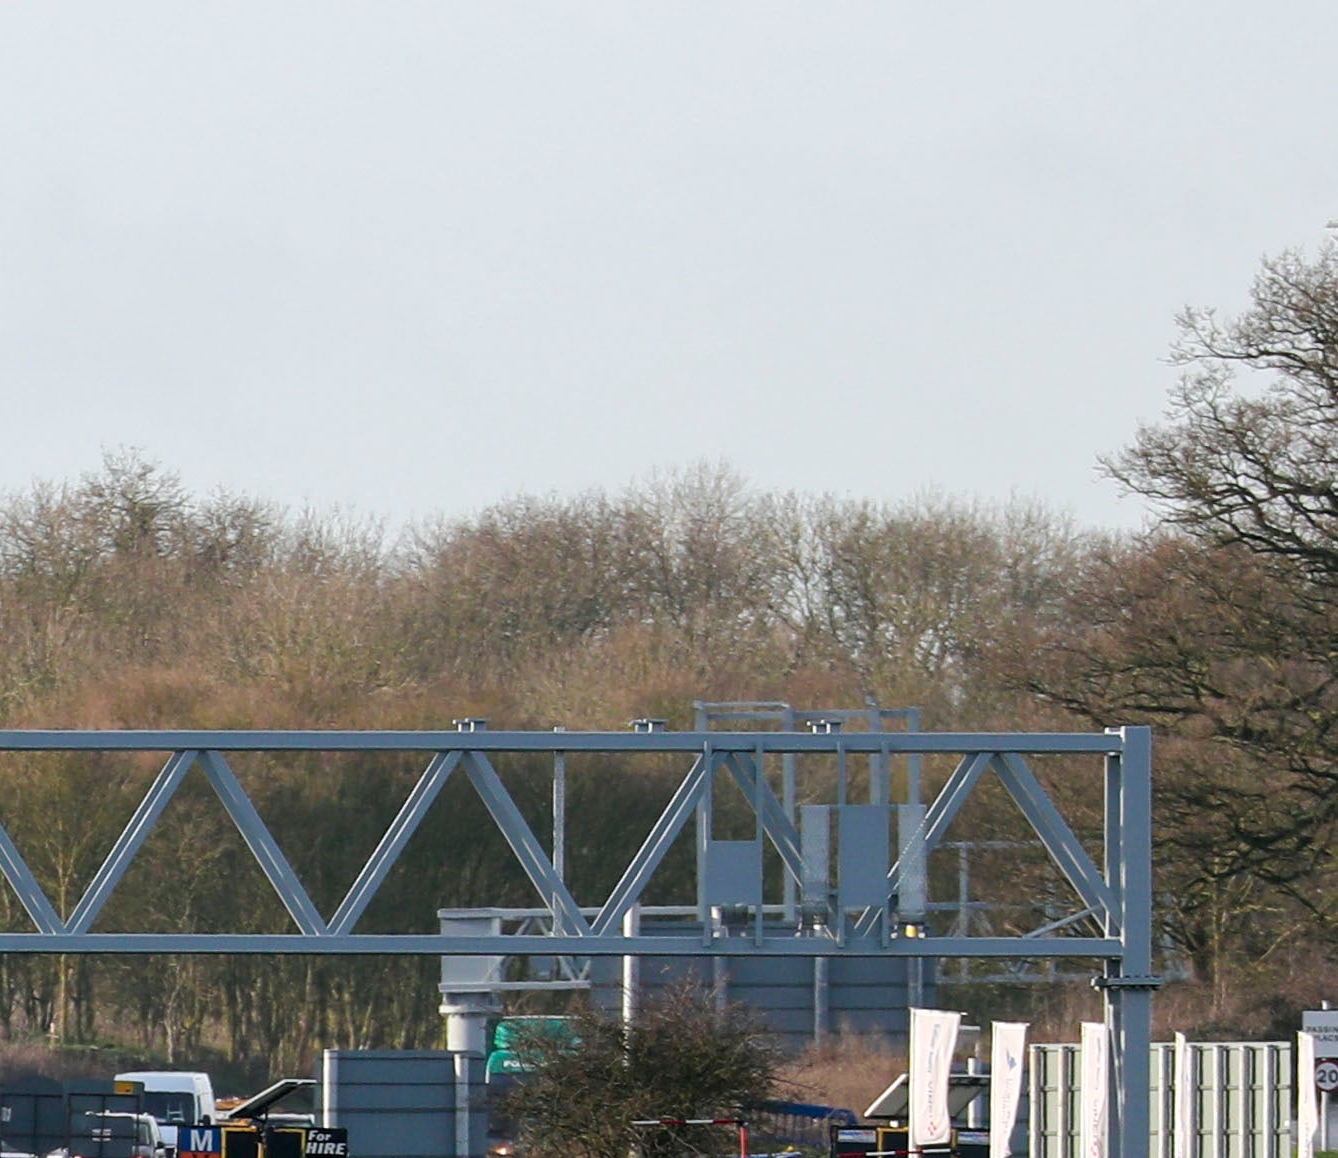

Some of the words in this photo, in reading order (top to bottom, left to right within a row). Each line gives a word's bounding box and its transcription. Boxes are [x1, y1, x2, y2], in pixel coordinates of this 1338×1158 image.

[1317, 1069, 1338, 1083] 20
[308, 1130, 332, 1141] For
[306, 1143, 345, 1156] HIRE
